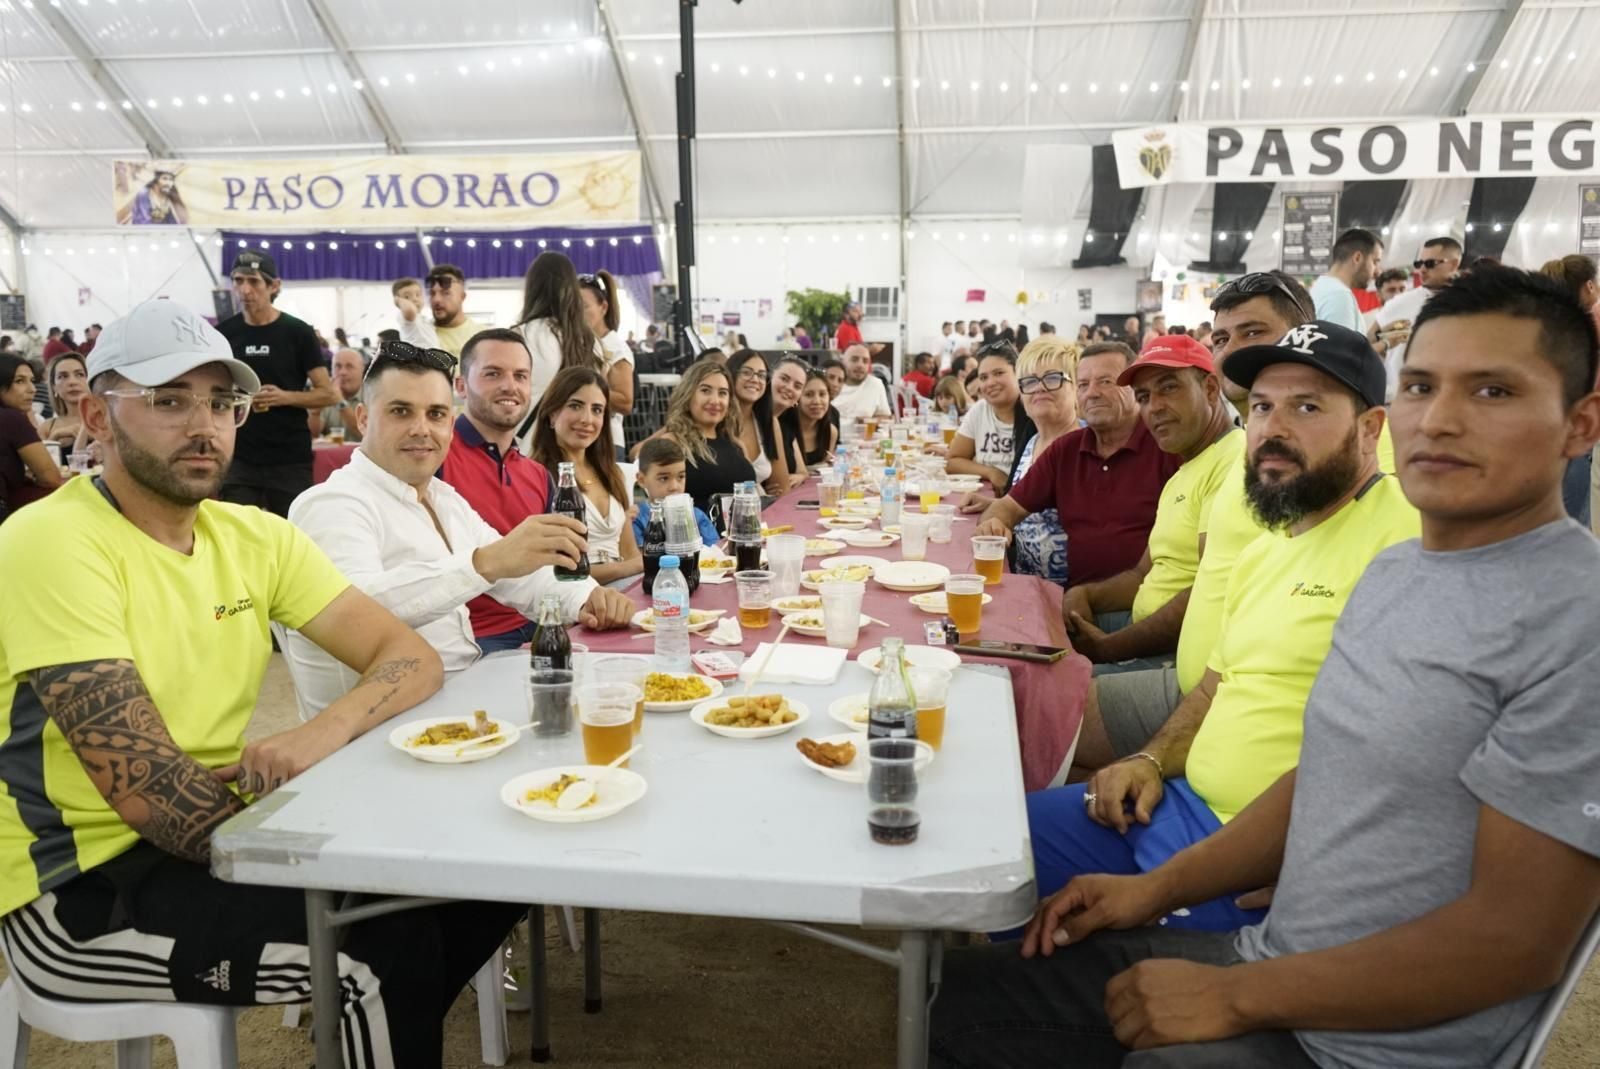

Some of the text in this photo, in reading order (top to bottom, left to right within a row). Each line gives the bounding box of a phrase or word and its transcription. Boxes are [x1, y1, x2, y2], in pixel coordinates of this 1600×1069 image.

[1205, 120, 1595, 176] PASO NEG
[221, 171, 560, 214] PASO MORAO
[1276, 324, 1329, 355] NY
[219, 960, 231, 991] adidas
